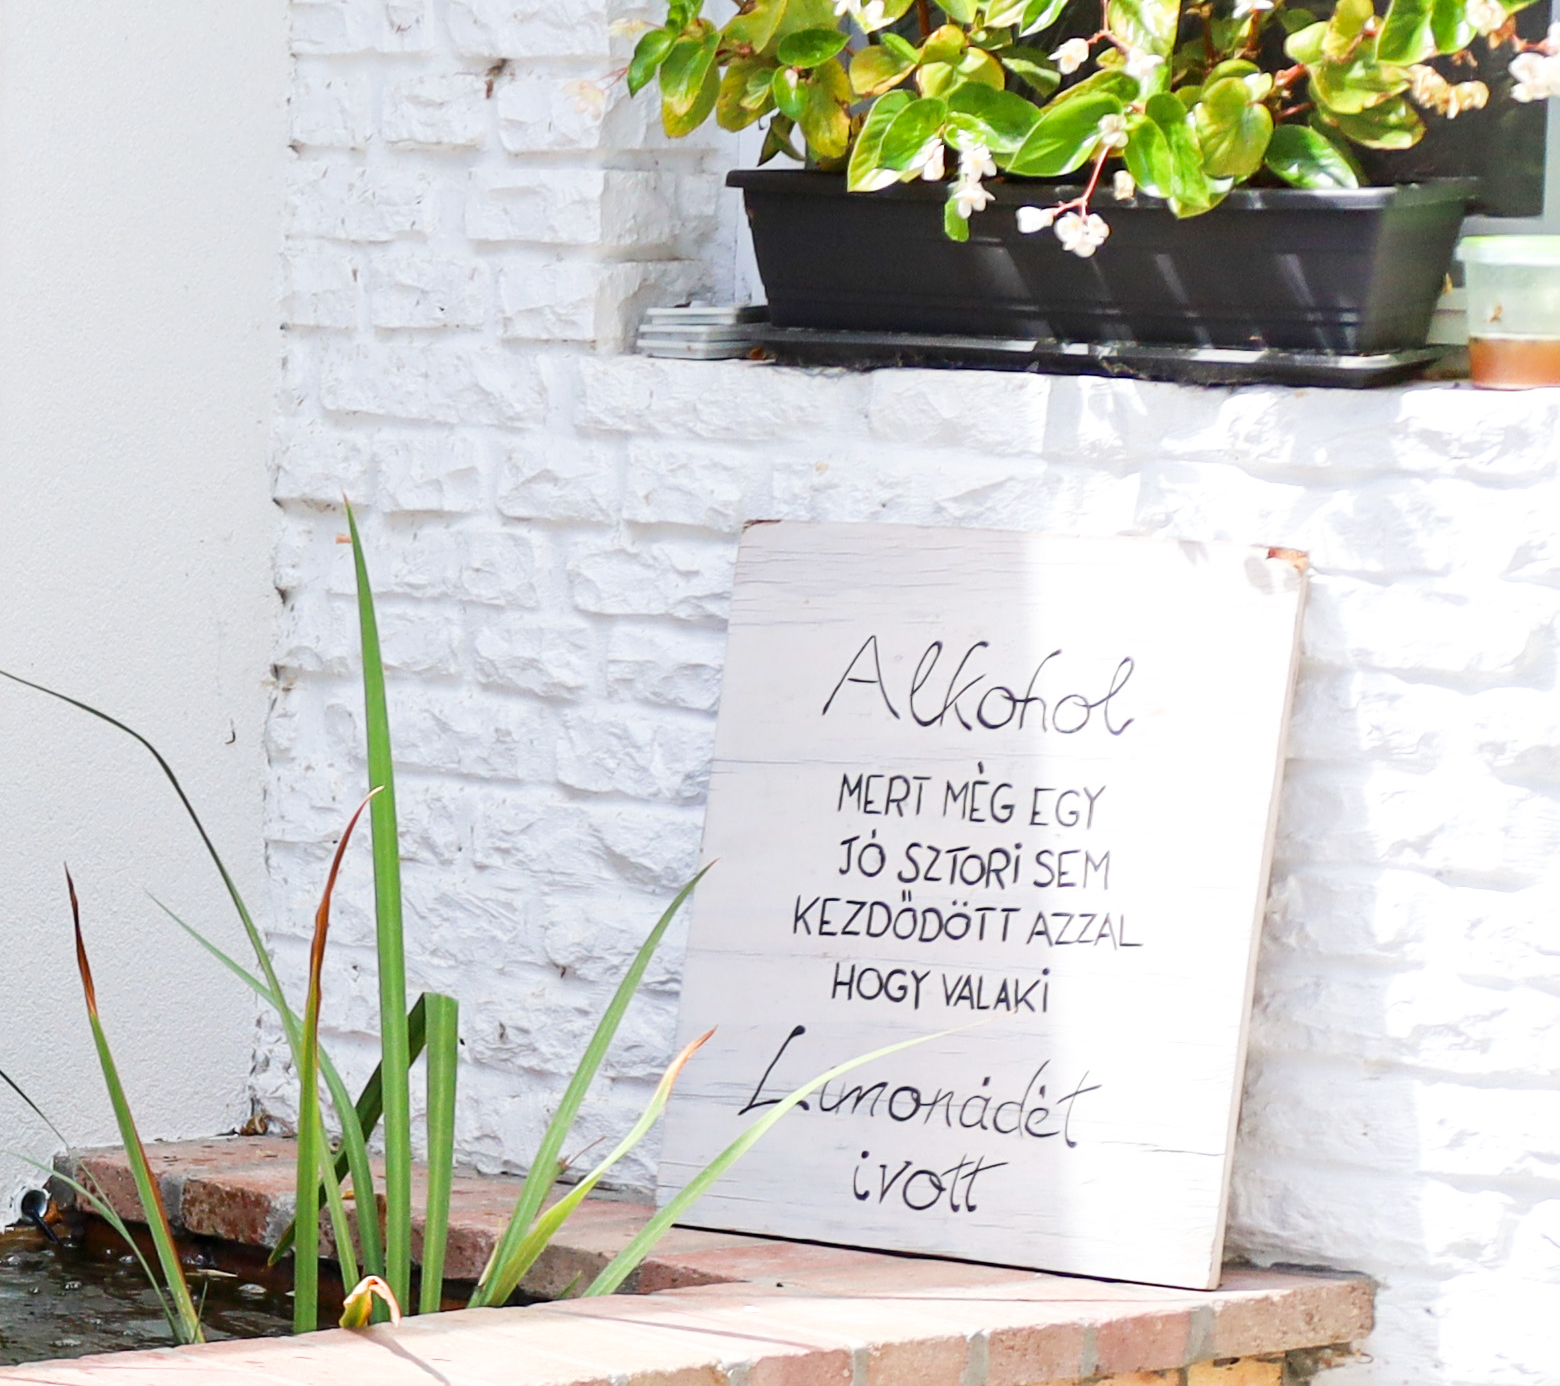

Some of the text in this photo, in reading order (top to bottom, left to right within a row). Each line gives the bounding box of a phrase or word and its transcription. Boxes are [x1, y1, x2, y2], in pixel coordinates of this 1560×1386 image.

[821, 635, 1136, 736] Alkohol
[837, 761, 1107, 830] MERT MÉG EGY
[838, 828, 887, 878] JÓ
[1032, 849, 1111, 890] SEM
[792, 889, 1144, 951] KEZDŐDÖTT AZZAL
[831, 962, 931, 1011] HOGY
[852, 1149, 1009, 1213] ivott
